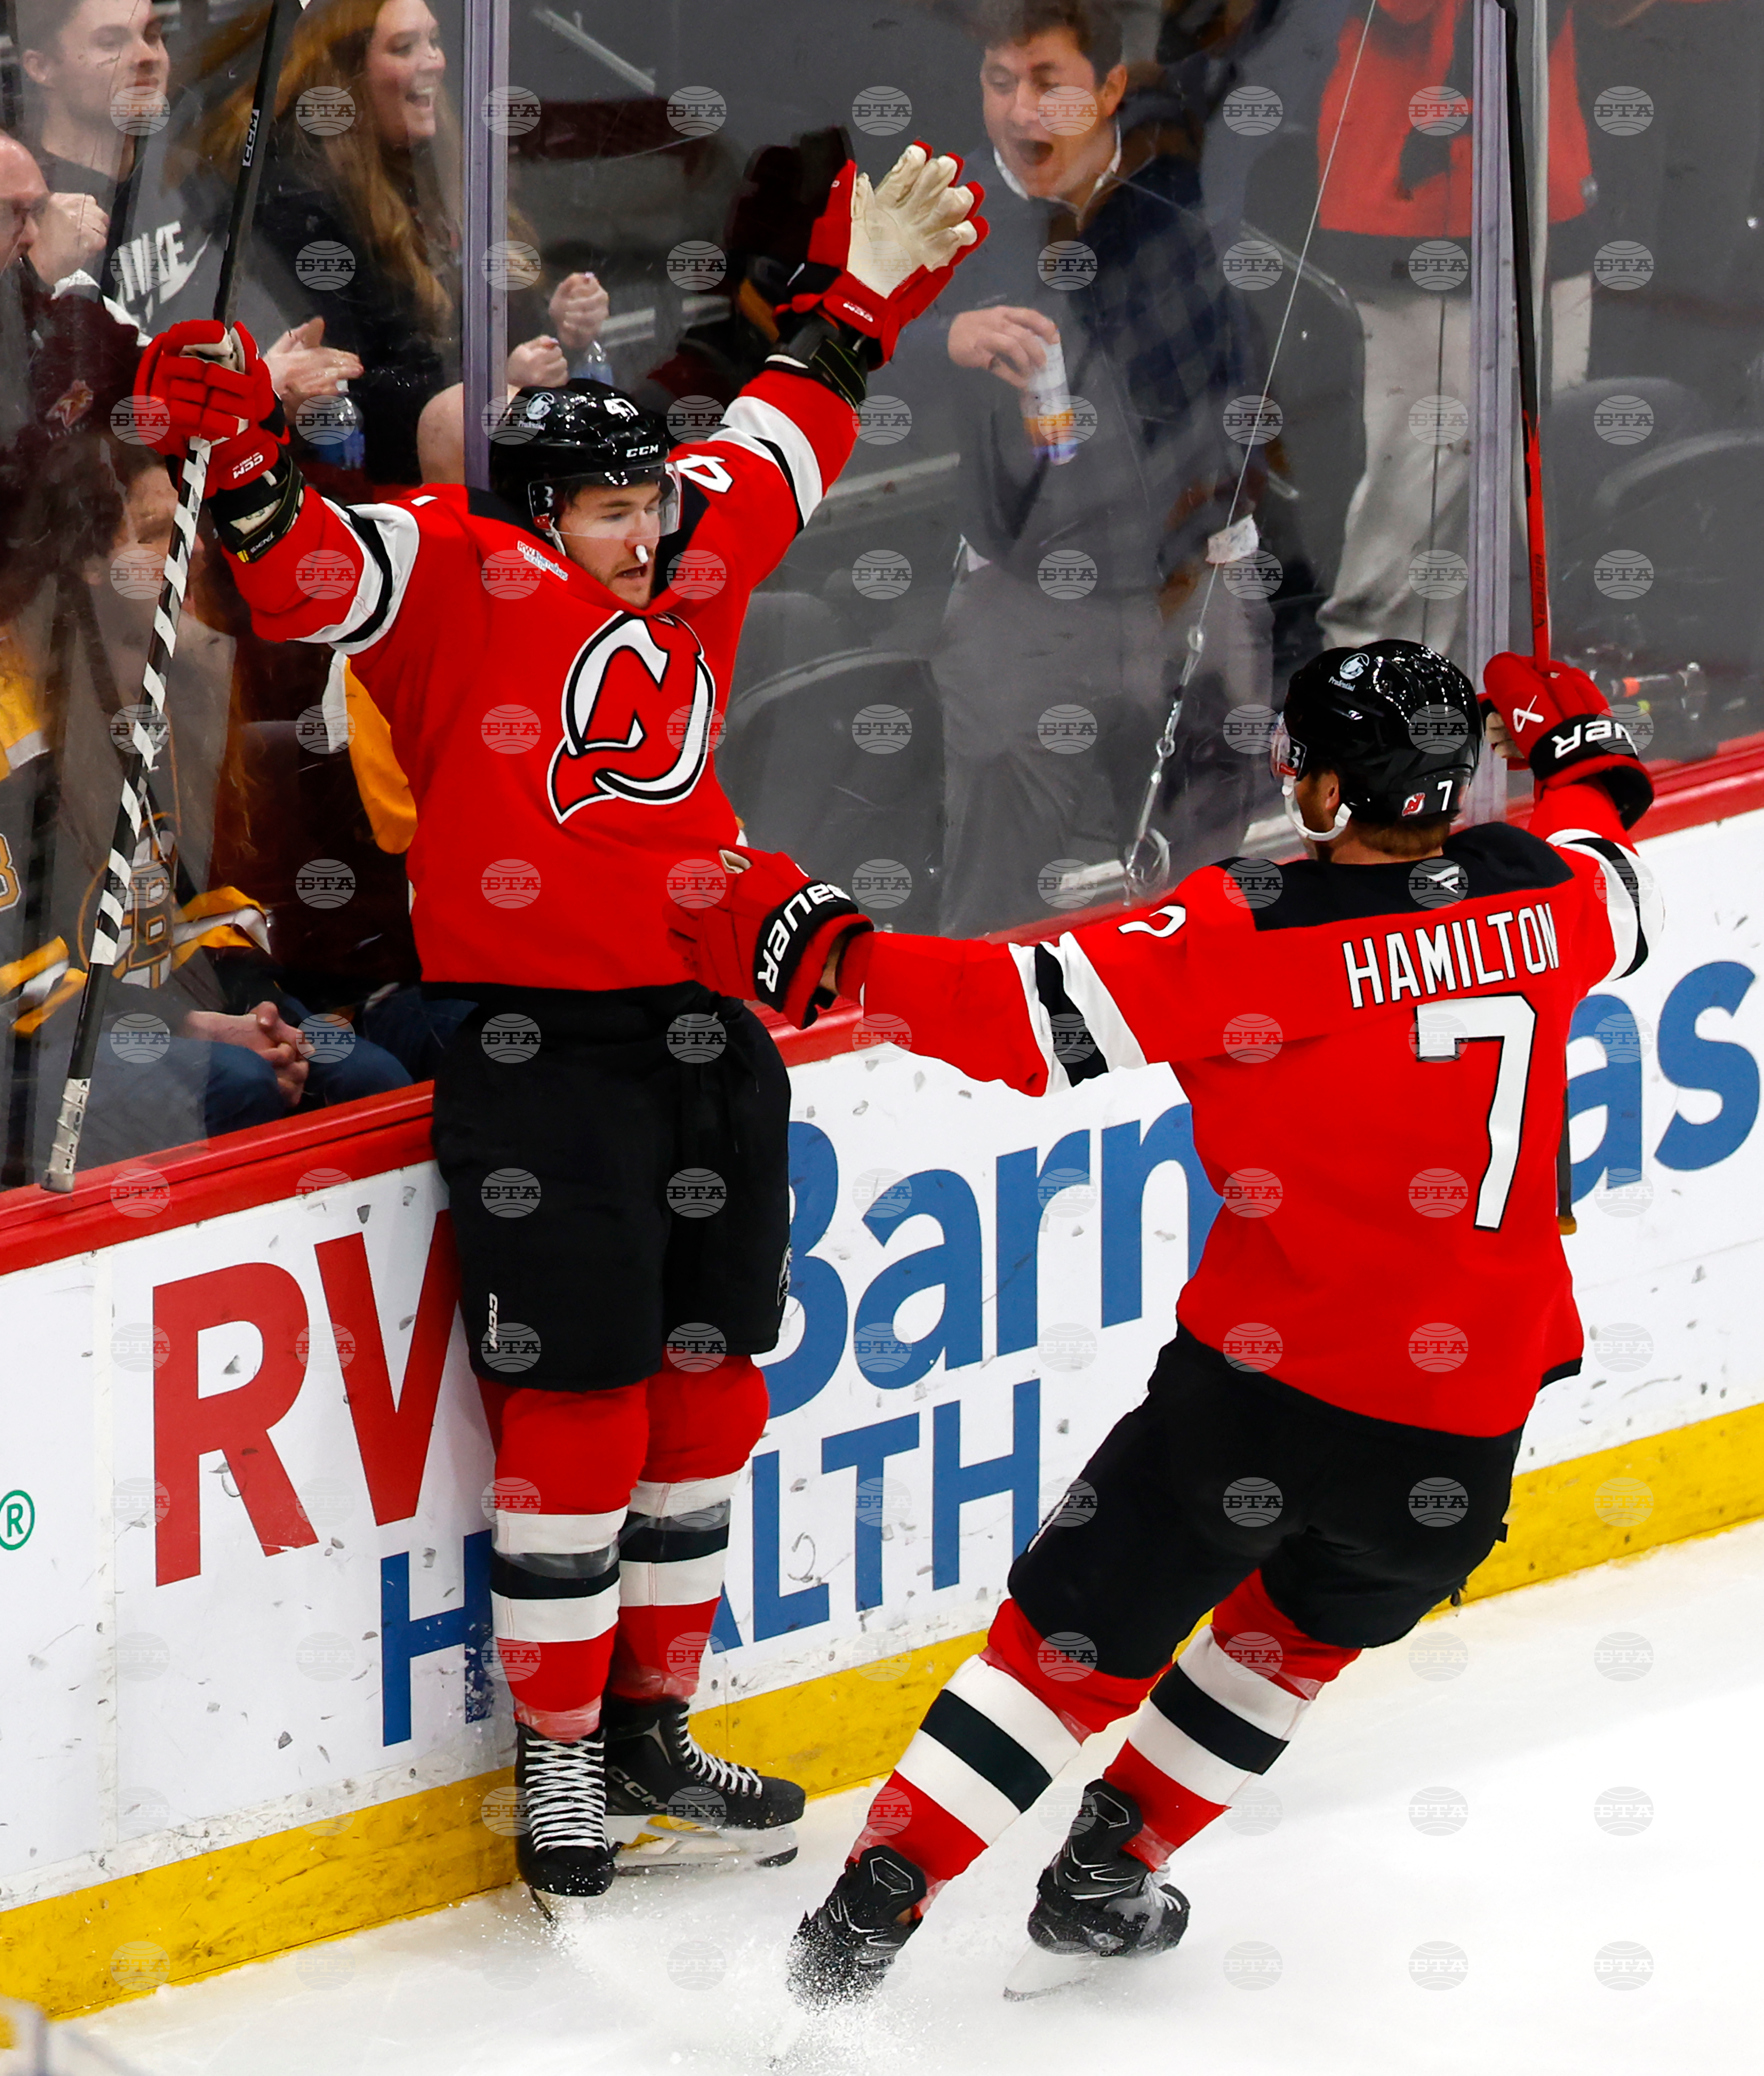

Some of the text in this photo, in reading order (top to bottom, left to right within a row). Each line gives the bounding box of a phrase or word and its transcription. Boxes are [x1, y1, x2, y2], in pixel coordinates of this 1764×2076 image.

[244, 112, 258, 162] CCM
[233, 454, 264, 479] CCM
[626, 444, 659, 458] CCM
[1437, 780, 1453, 812] 7
[1342, 903, 1560, 1009] HAMILTON
[1415, 993, 1537, 1233] 7
[487, 1292, 498, 1350] CCM
[606, 1766, 669, 1811] CCM
